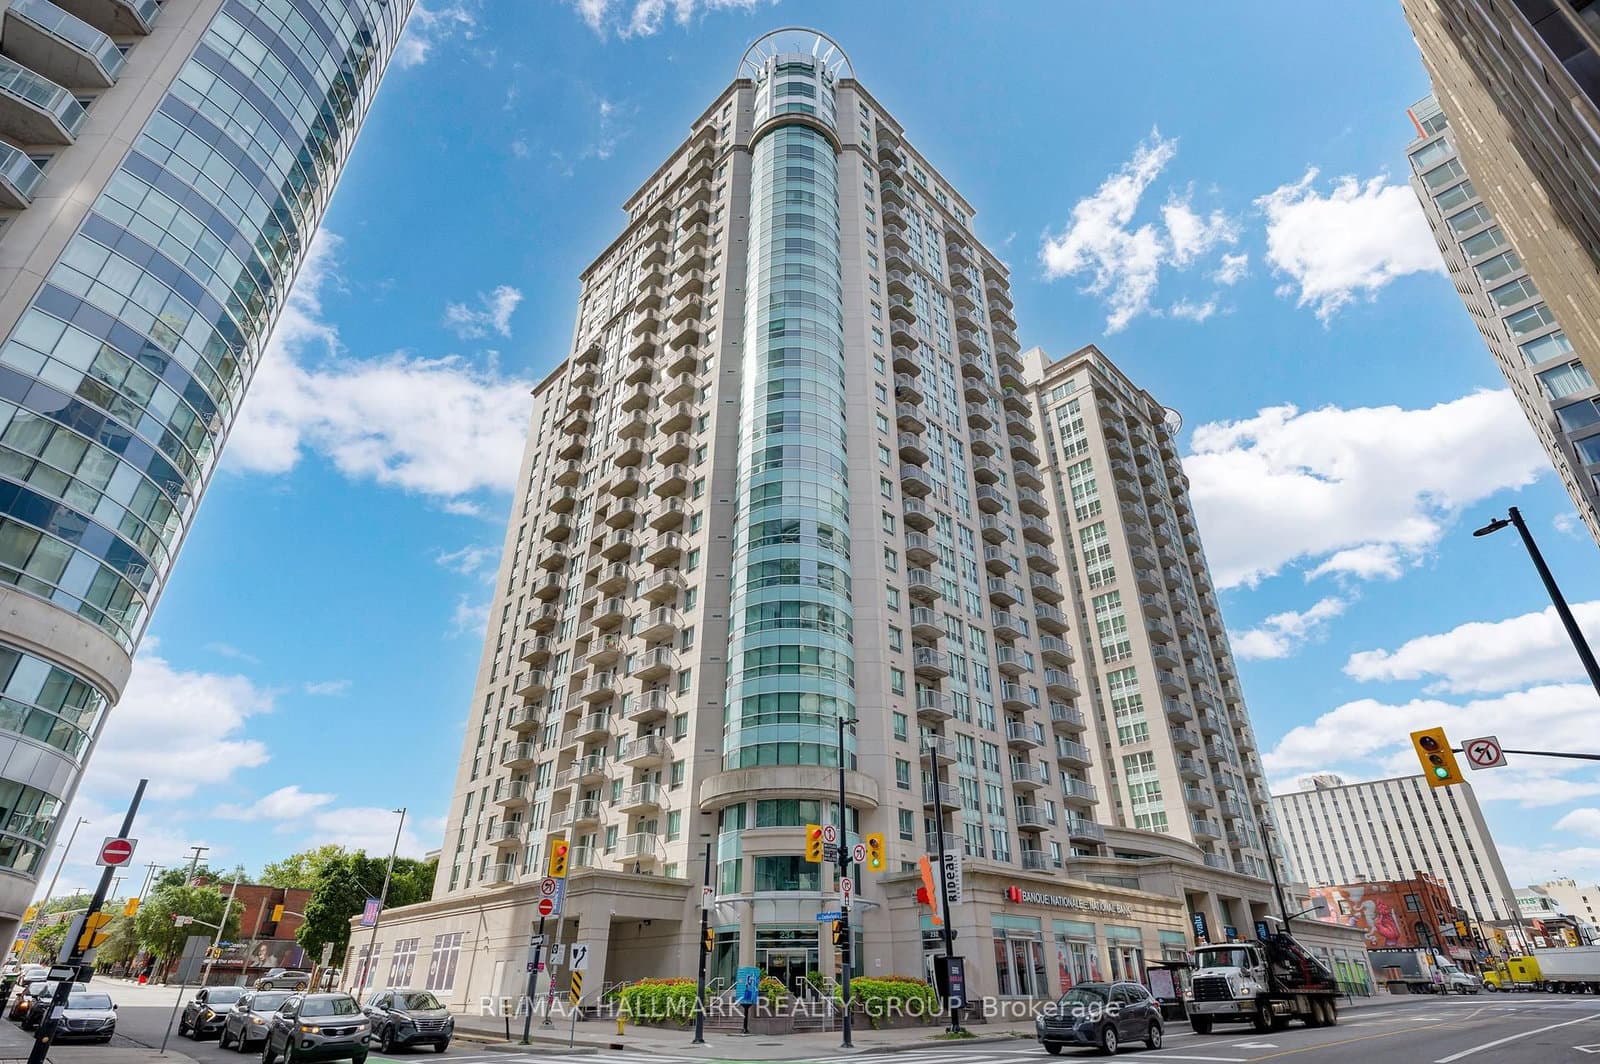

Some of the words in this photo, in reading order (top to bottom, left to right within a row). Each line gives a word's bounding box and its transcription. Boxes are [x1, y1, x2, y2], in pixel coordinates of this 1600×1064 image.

[1022, 890, 1049, 905] BANQUE
[1049, 894, 1085, 910] NATIONALE
[1089, 898, 1116, 913] NATIONAL
[779, 930, 795, 939] 234
